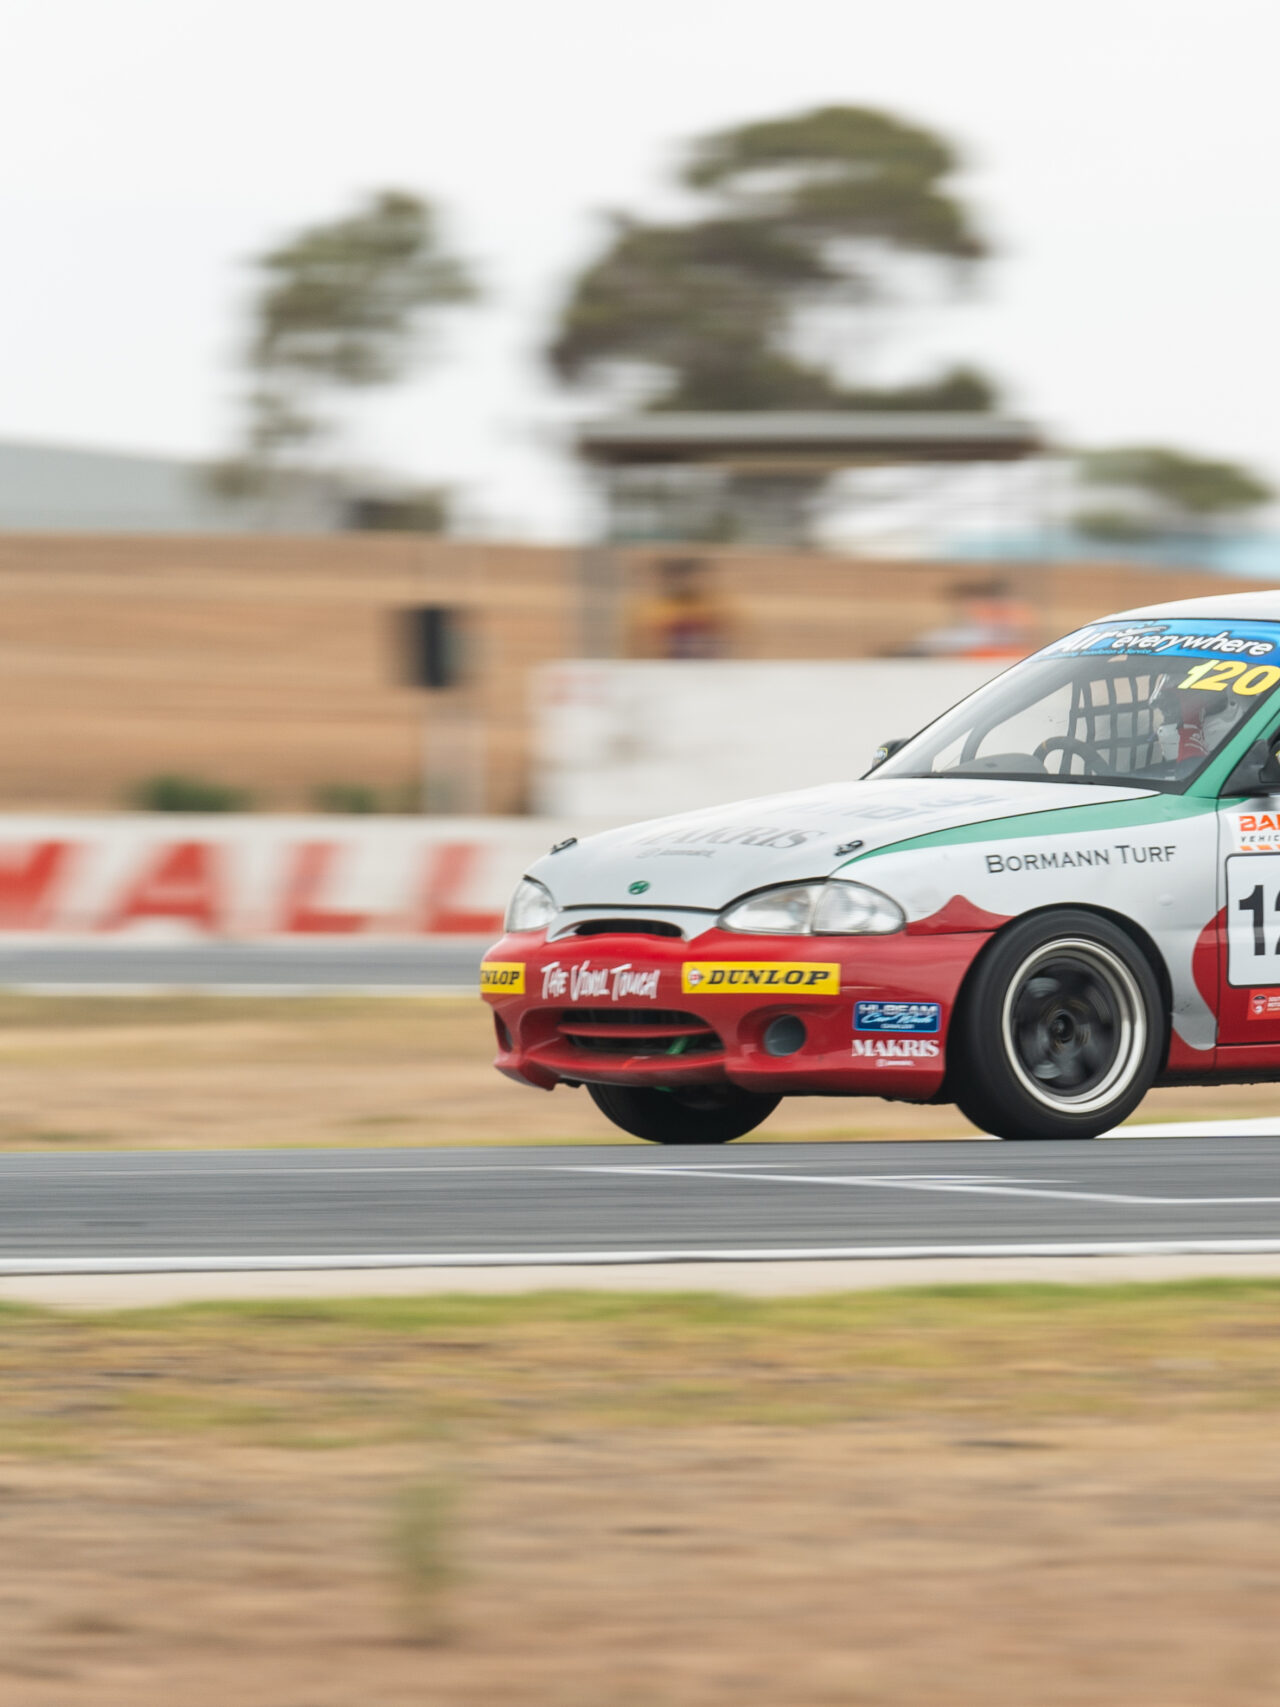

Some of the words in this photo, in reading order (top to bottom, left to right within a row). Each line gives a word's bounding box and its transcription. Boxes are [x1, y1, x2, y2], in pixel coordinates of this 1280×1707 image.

[1111, 631, 1274, 656] everywhere
[985, 849, 1111, 874] BORMANN
[1114, 844, 1177, 864] TURF
[706, 970, 831, 985] DUNLOP
[851, 1039, 939, 1057] MAKRIS
